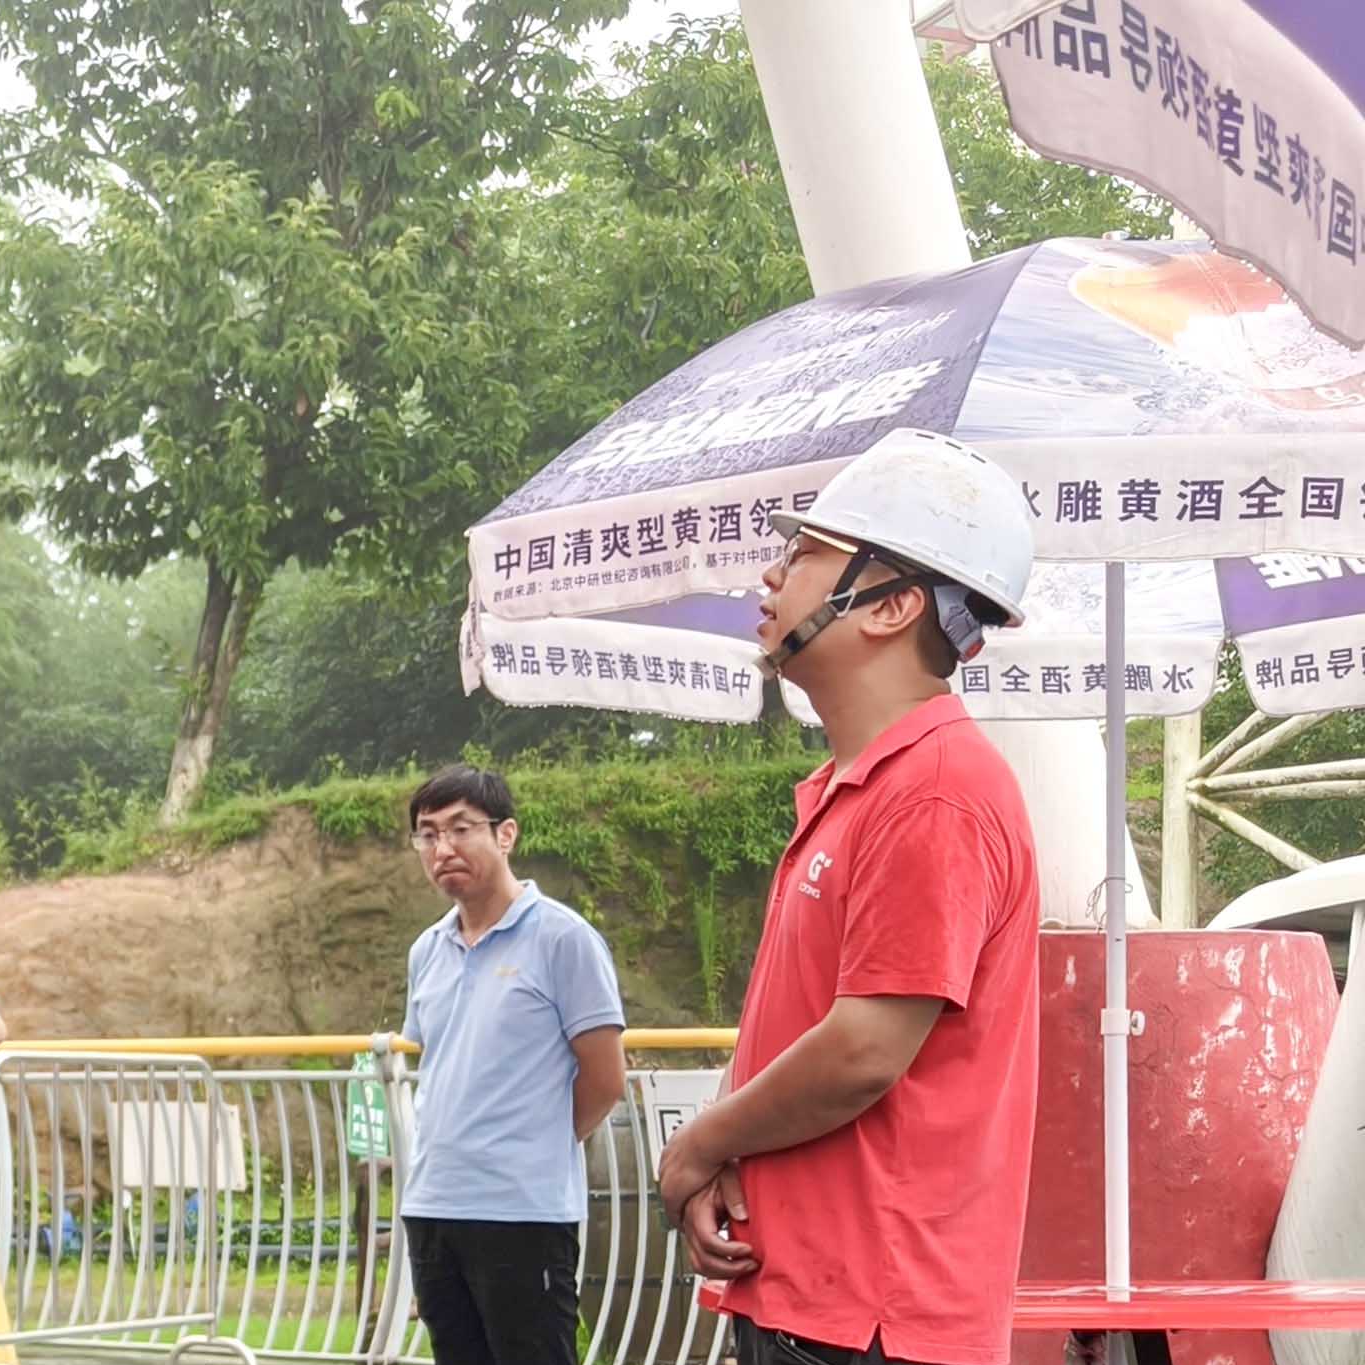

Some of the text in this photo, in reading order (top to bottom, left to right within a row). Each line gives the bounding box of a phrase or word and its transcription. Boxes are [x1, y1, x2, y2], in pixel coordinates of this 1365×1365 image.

[1021, 476, 1365, 524] 雕黄酒全国
